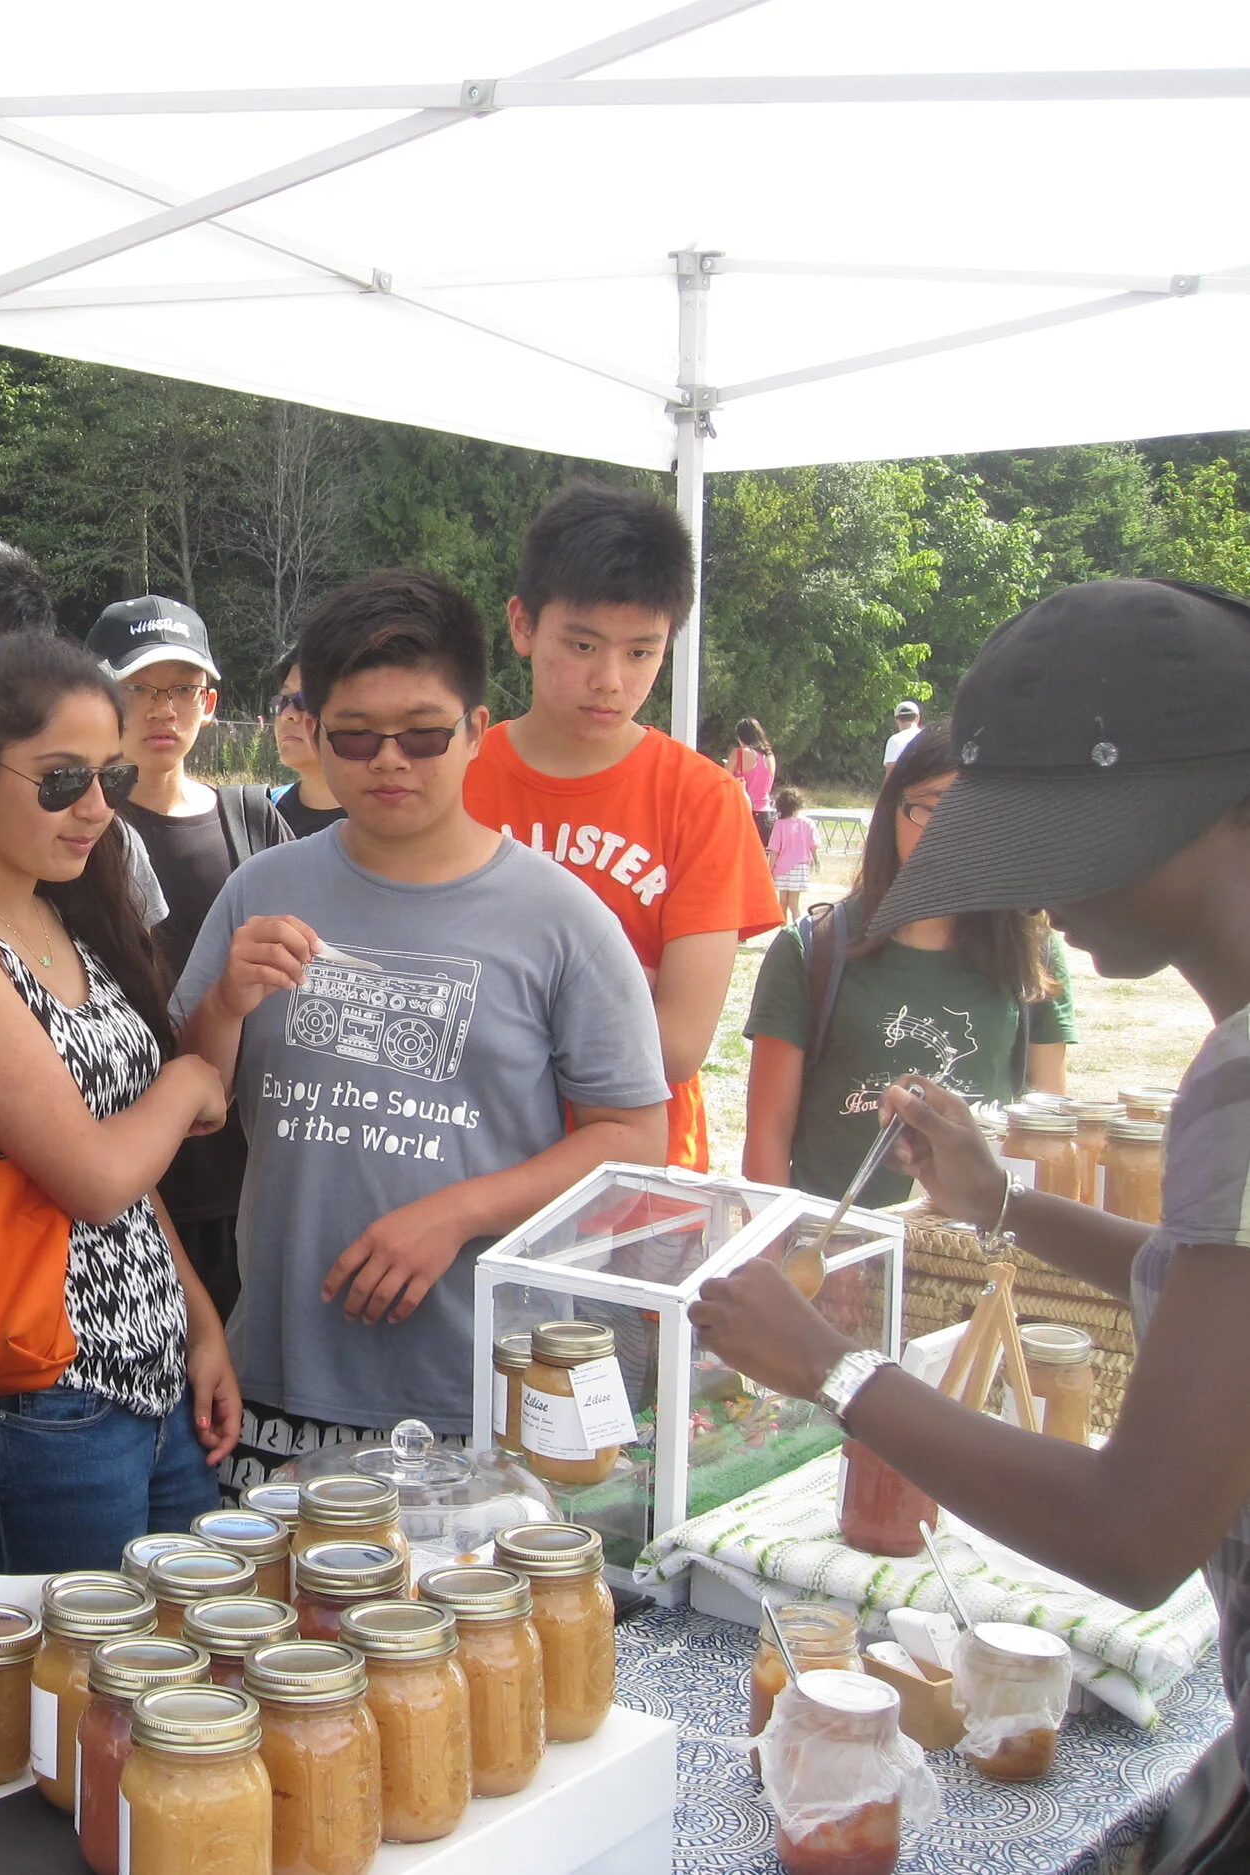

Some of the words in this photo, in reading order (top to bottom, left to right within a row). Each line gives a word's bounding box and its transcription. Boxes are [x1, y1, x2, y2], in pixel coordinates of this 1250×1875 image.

[262, 1073, 321, 1111] Enjoy
[331, 1081, 379, 1110] the
[386, 1090, 480, 1129] Sounds
[277, 1117, 298, 1141] of
[304, 1115, 350, 1145] the
[362, 1124, 445, 1162] World.
